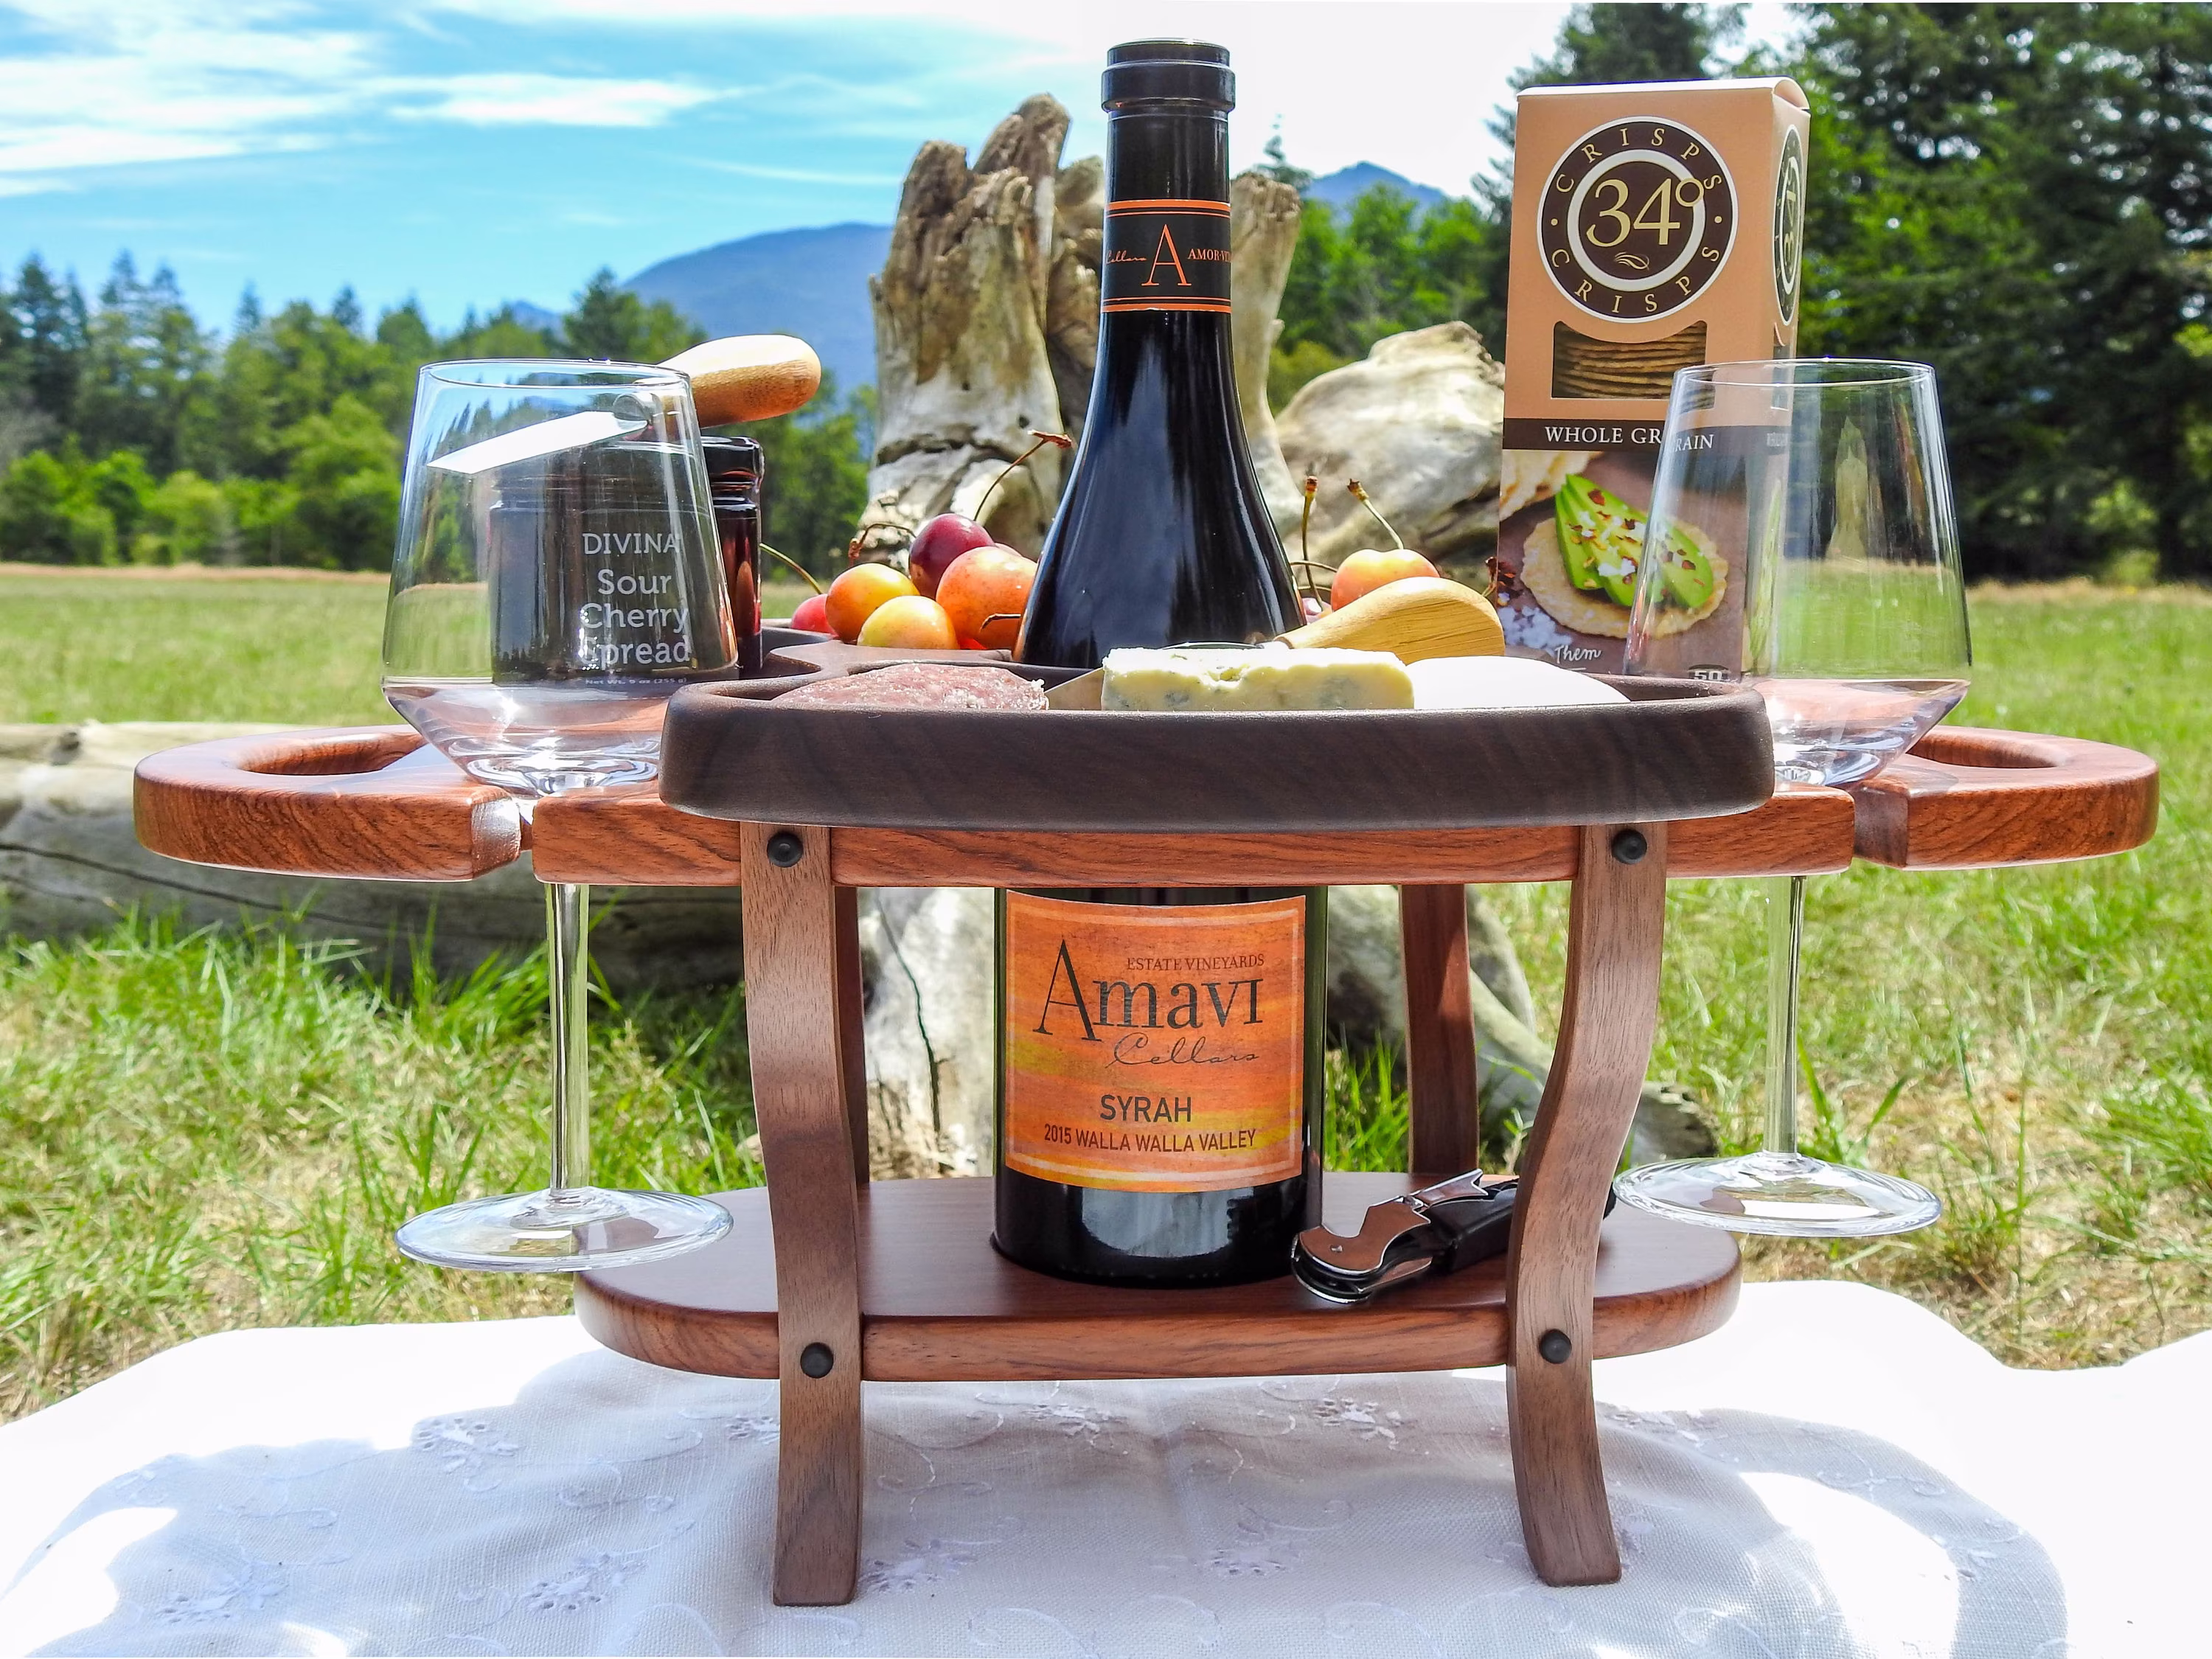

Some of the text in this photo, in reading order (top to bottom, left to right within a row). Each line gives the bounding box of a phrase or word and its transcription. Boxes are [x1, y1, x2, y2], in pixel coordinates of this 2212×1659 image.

[1556, 128, 1722, 193] CRISPS
[1141, 223, 1192, 286] A
[1551, 246, 1721, 314] CRISPS
[1545, 426, 1624, 444] WHOLE
[582, 532, 680, 554] DIVINA
[597, 568, 672, 595] Sour
[580, 603, 689, 633] Cherry
[1554, 644, 1601, 664] Them
[1127, 954, 1265, 972] ESTATE VINEYARDS
[1105, 1032, 1259, 1068] Cellars
[1100, 1094, 1192, 1122] SYRAH
[1044, 1124, 1256, 1152] 2015 WALLA WALLA VALLEY
